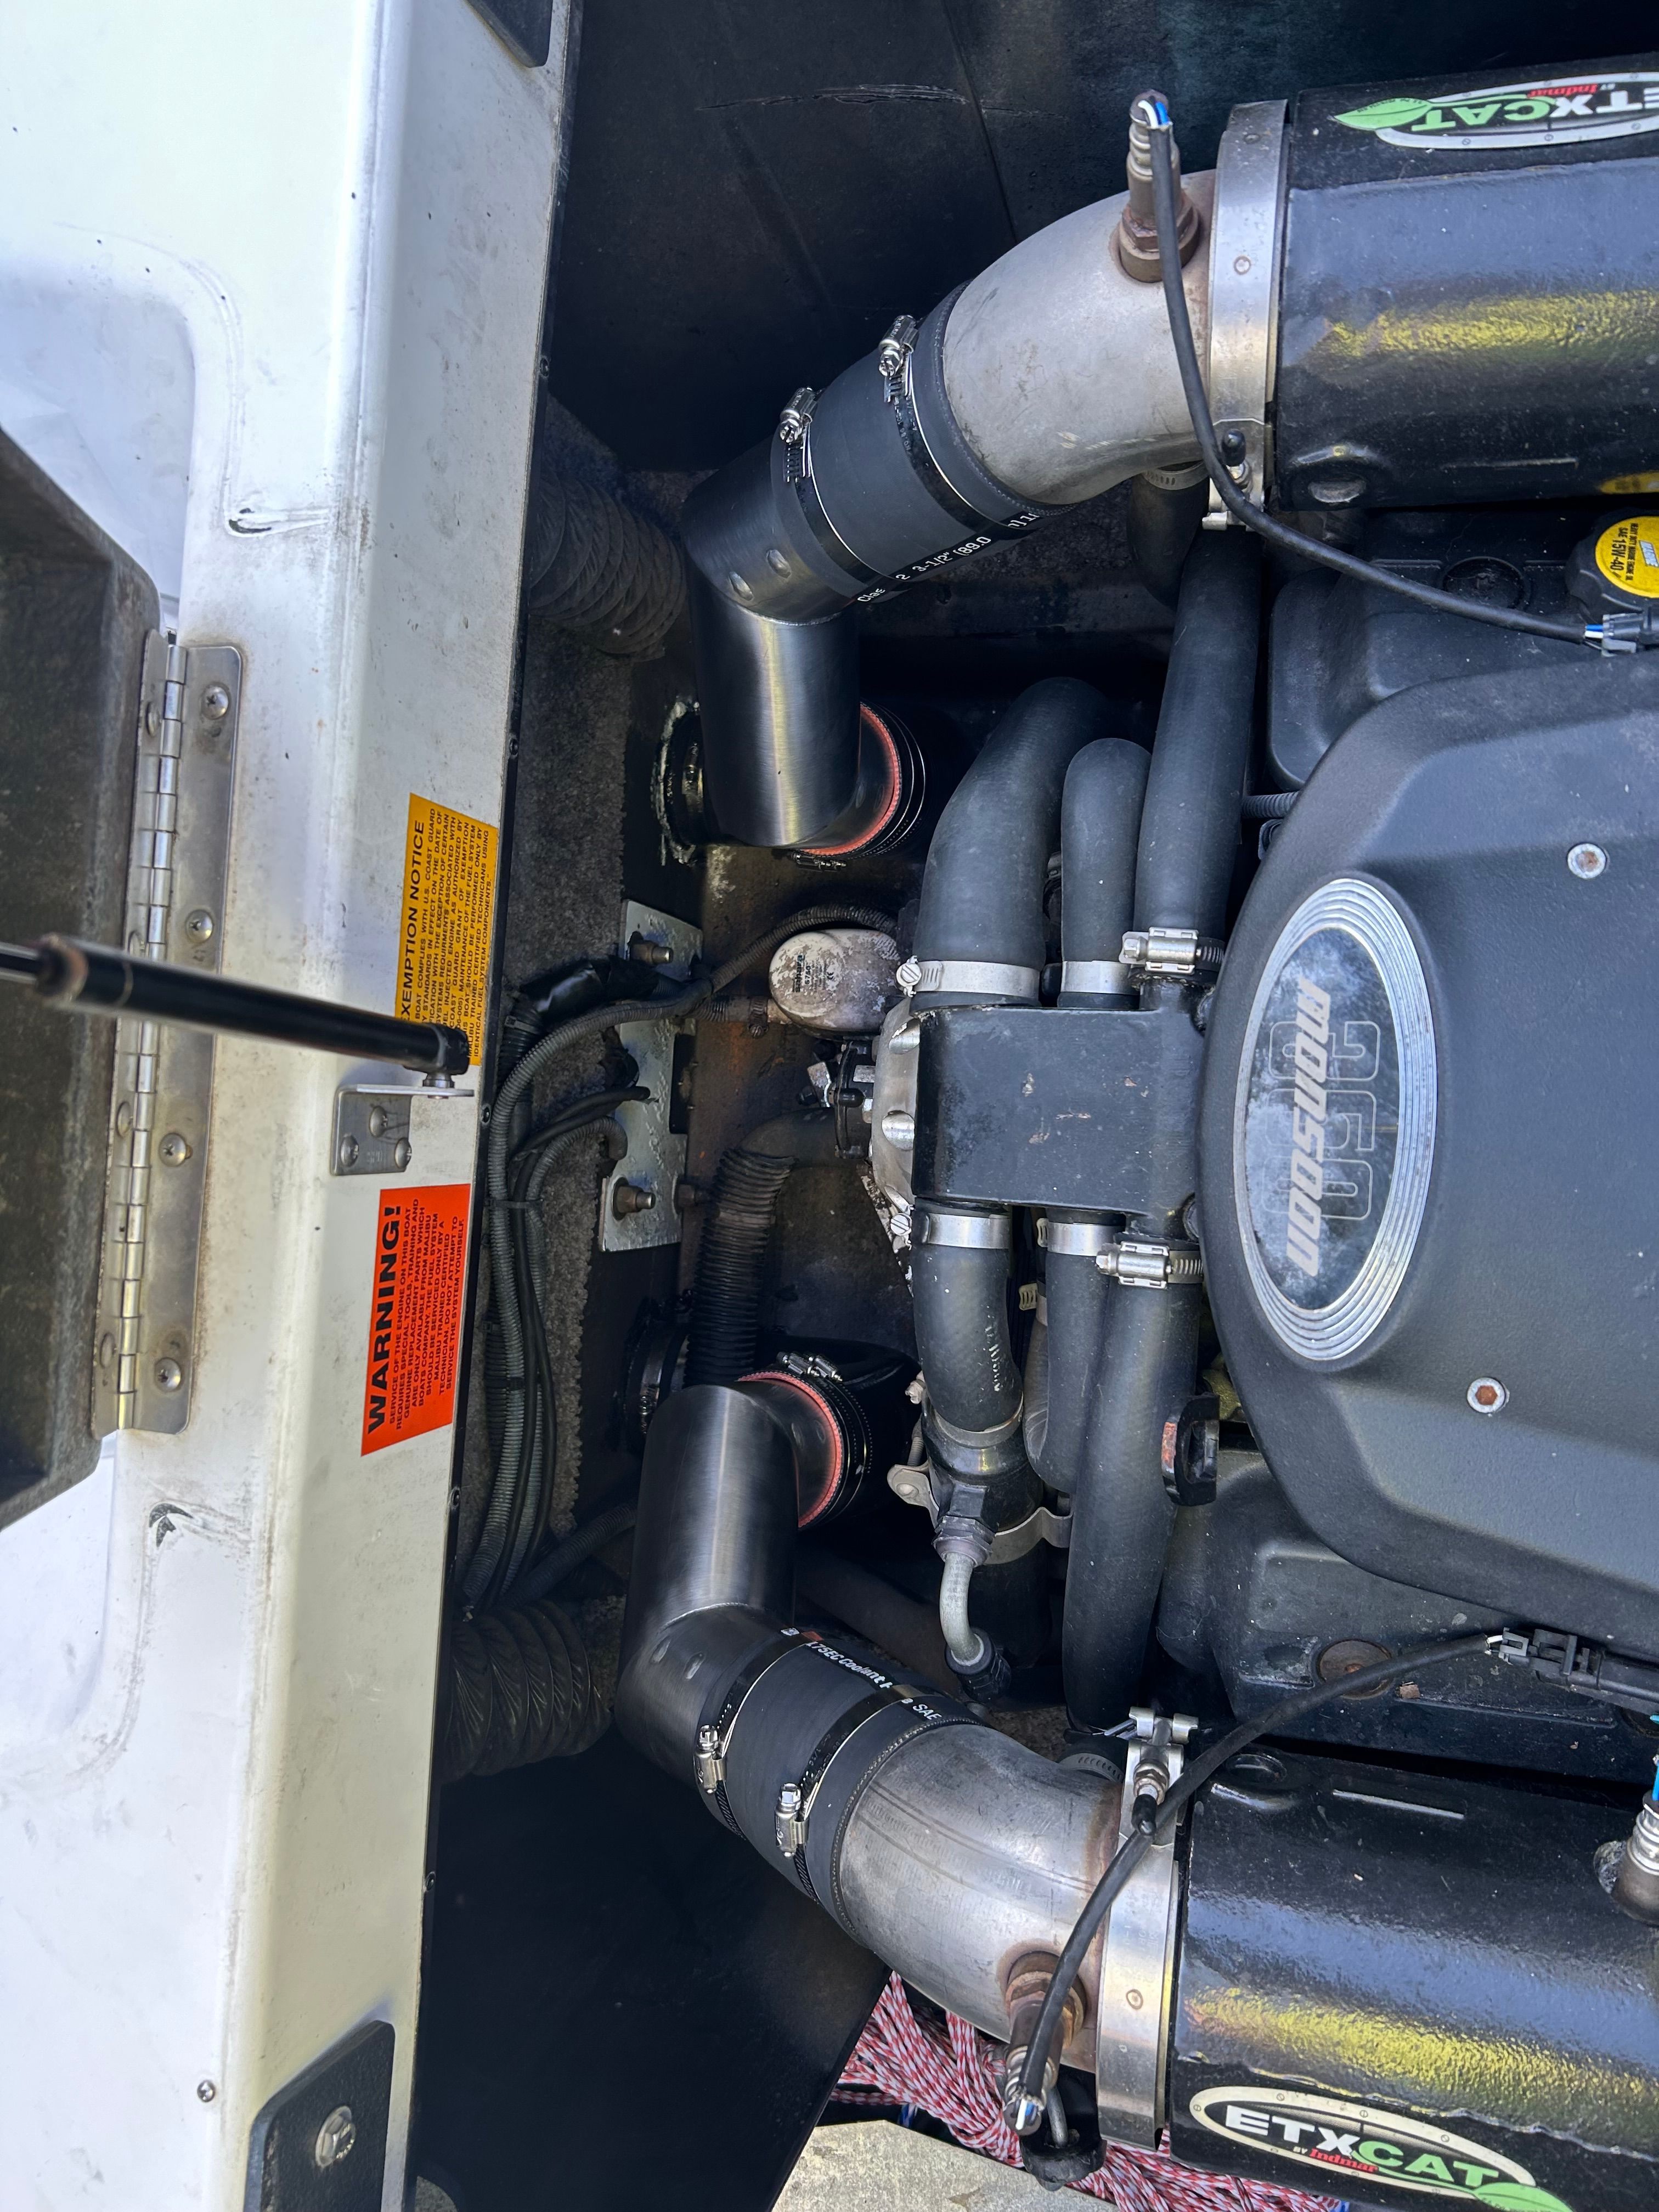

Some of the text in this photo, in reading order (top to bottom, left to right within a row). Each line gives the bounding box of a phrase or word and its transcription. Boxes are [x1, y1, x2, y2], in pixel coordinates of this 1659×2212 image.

[1527, 83, 1599, 98] Indmar
[1610, 527, 1628, 571] SAE 15W-40
[456, 819, 462, 832] BY
[476, 827, 482, 839] BY
[409, 821, 424, 900] NOTICE
[439, 857, 445, 871] OF
[444, 844, 454, 905] ASSOCIATED
[452, 837, 461, 896] AUTHORIZED
[460, 822, 469, 880] EXEMPTION
[422, 953, 432, 1011] STANDARDS
[427, 939, 433, 949] IN
[431, 879, 437, 895] ON
[436, 810, 442, 825] OF
[436, 874, 444, 928] EXCEPTION
[450, 901, 456, 914] AS
[458, 887, 464, 901] OF
[470, 871, 478, 929] PERFORMED
[469, 933, 474, 946] BE
[473, 928, 481, 975] CERTIFIED
[477, 862, 486, 923] TECHNICIANS
[417, 938, 426, 988] COMPLIES
[458, 926, 468, 992] MAINTENANCE
[464, 909, 469, 923] OF
[444, 960, 452, 1005] INJECTED
[473, 1011, 482, 1057] IDENTICAL
[430, 1213, 438, 1255] SYSTEM
[437, 1231, 443, 1245] BY
[451, 1216, 458, 1231] TO
[407, 1225, 416, 1277] TRAINING
[448, 1234, 456, 1280] ATTEMPT
[399, 1268, 406, 1285] ON
[437, 1291, 445, 1336] TRAINED
[441, 1233, 449, 1288] CERTIFIED
[369, 1207, 399, 1431] WARNING!
[396, 1288, 404, 1330] ENGINE
[416, 1294, 425, 1351] AVAILABLE
[431, 1278, 439, 1331] SERVICED
[444, 1308, 450, 1324] DO
[400, 1323, 409, 1370] SPECIAL
[404, 1369, 412, 1418] GENUINE
[408, 1286, 418, 1365] REPLACEMENT
[414, 1247, 422, 1282] PARTS
[429, 1334, 435, 1348] BE
[445, 1345, 454, 1389] SERVICE
[451, 1277, 459, 1318] SYSTEM
[393, 1358, 399, 1373] OF
[426, 1351, 434, 1395] SHOULD
[390, 1376, 398, 1424] SERVICE
[396, 1373, 405, 1429] REQUIRES
[838, 1658, 886, 1684] Coolant
[912, 1704, 942, 1720] SAE
[1226, 2105, 1499, 2187] ETXCAT
[1293, 2146, 1379, 2174] BY Indmar
